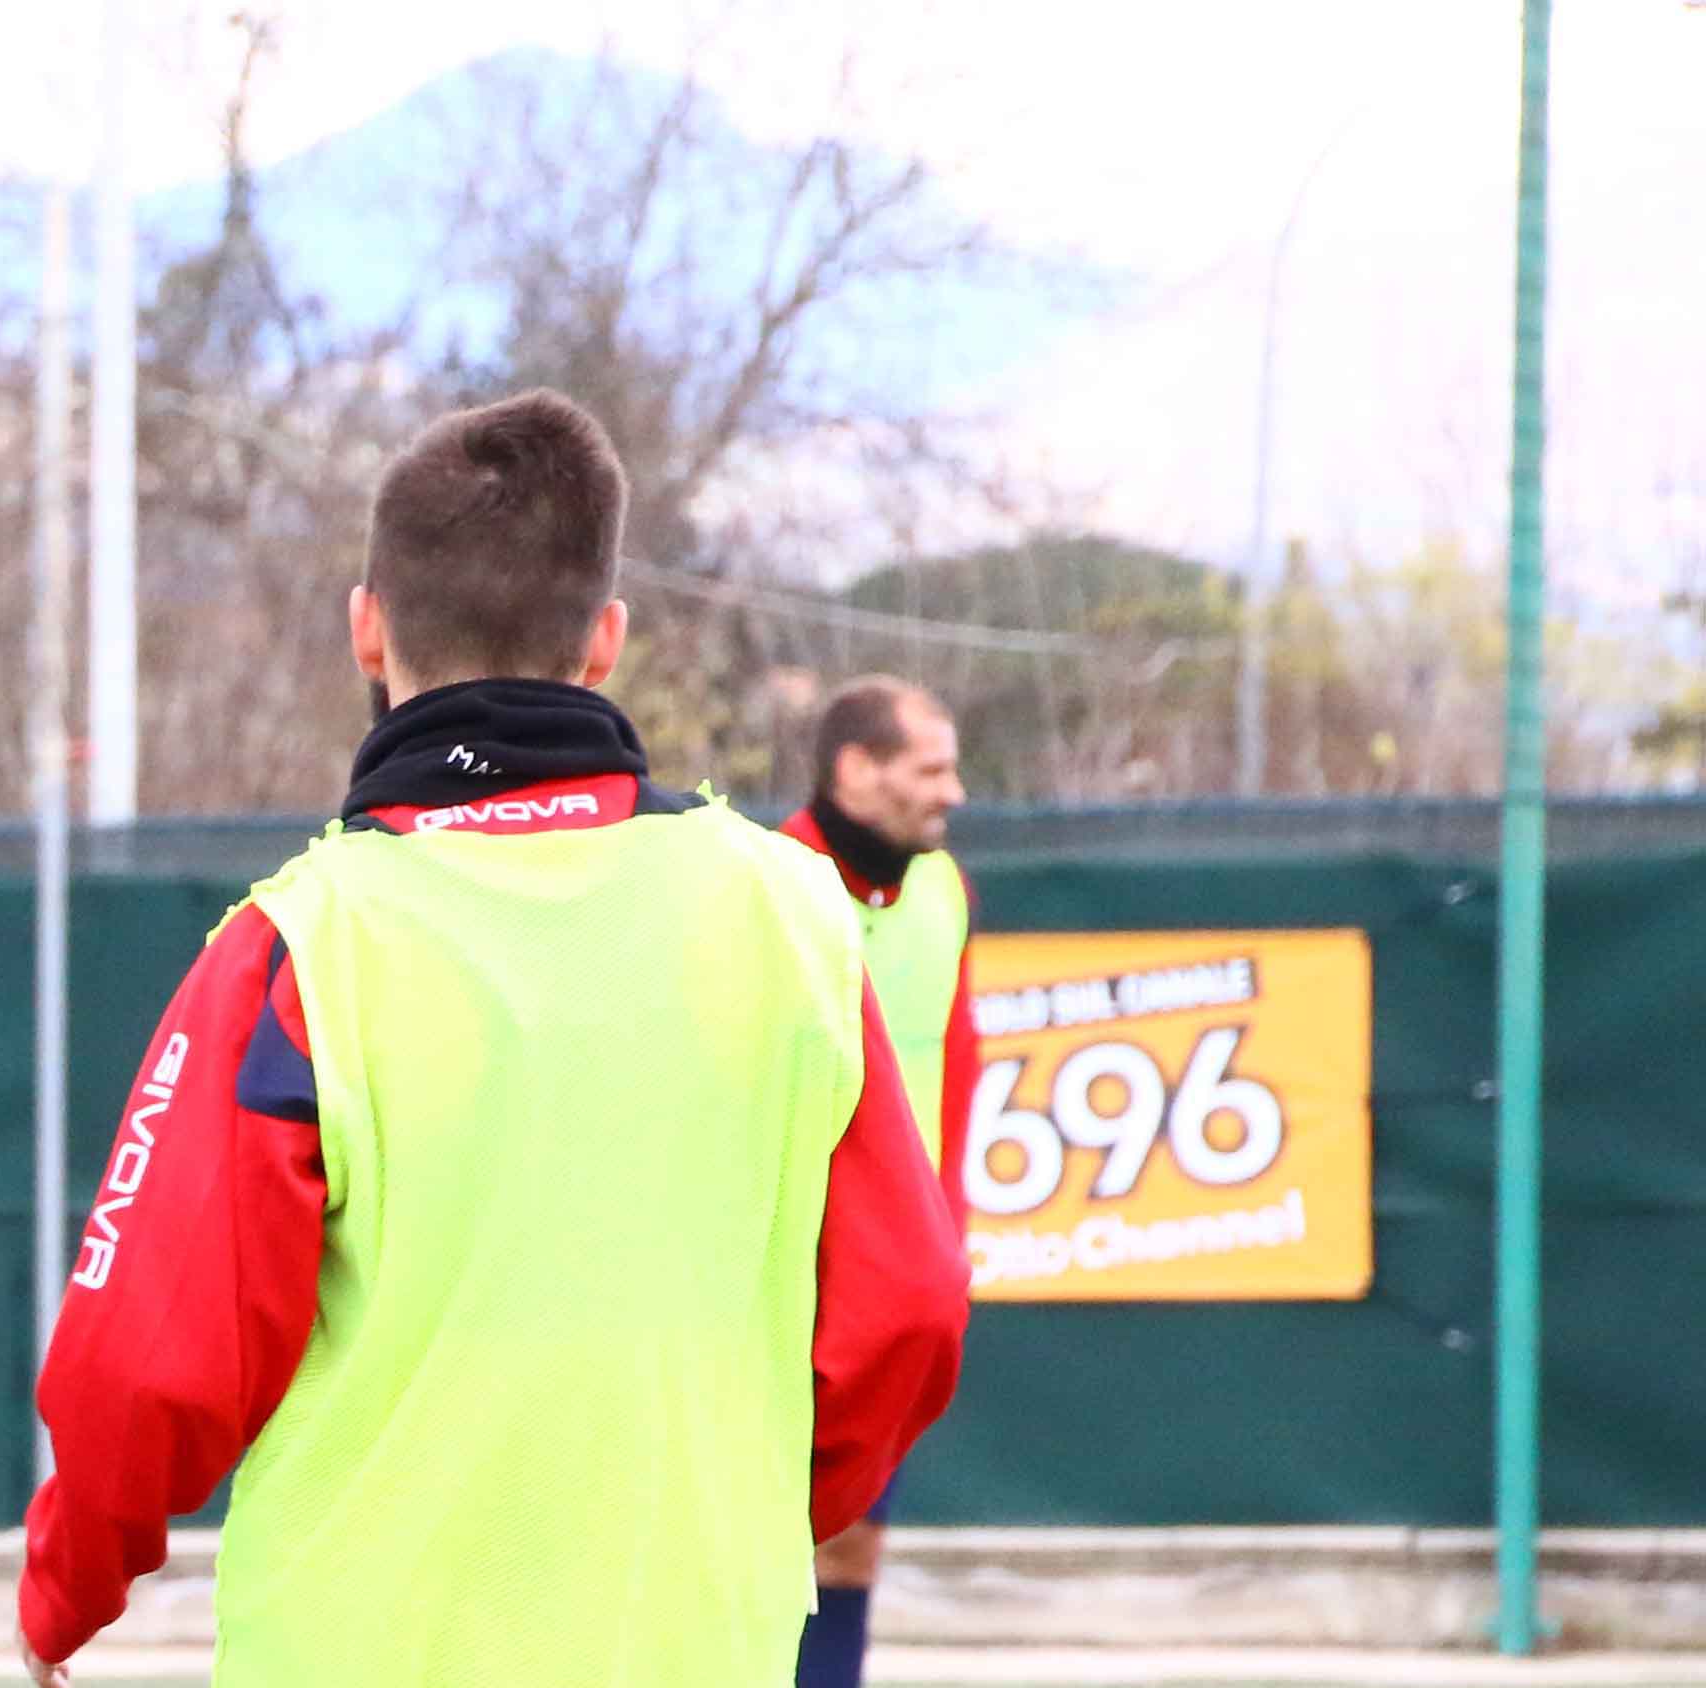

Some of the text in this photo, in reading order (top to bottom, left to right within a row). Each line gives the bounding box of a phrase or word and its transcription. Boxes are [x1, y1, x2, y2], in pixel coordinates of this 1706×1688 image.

[414, 793, 599, 835] GIVOVA
[73, 1032, 189, 1290] GIVOVA
[962, 1024, 1283, 1215] 696
